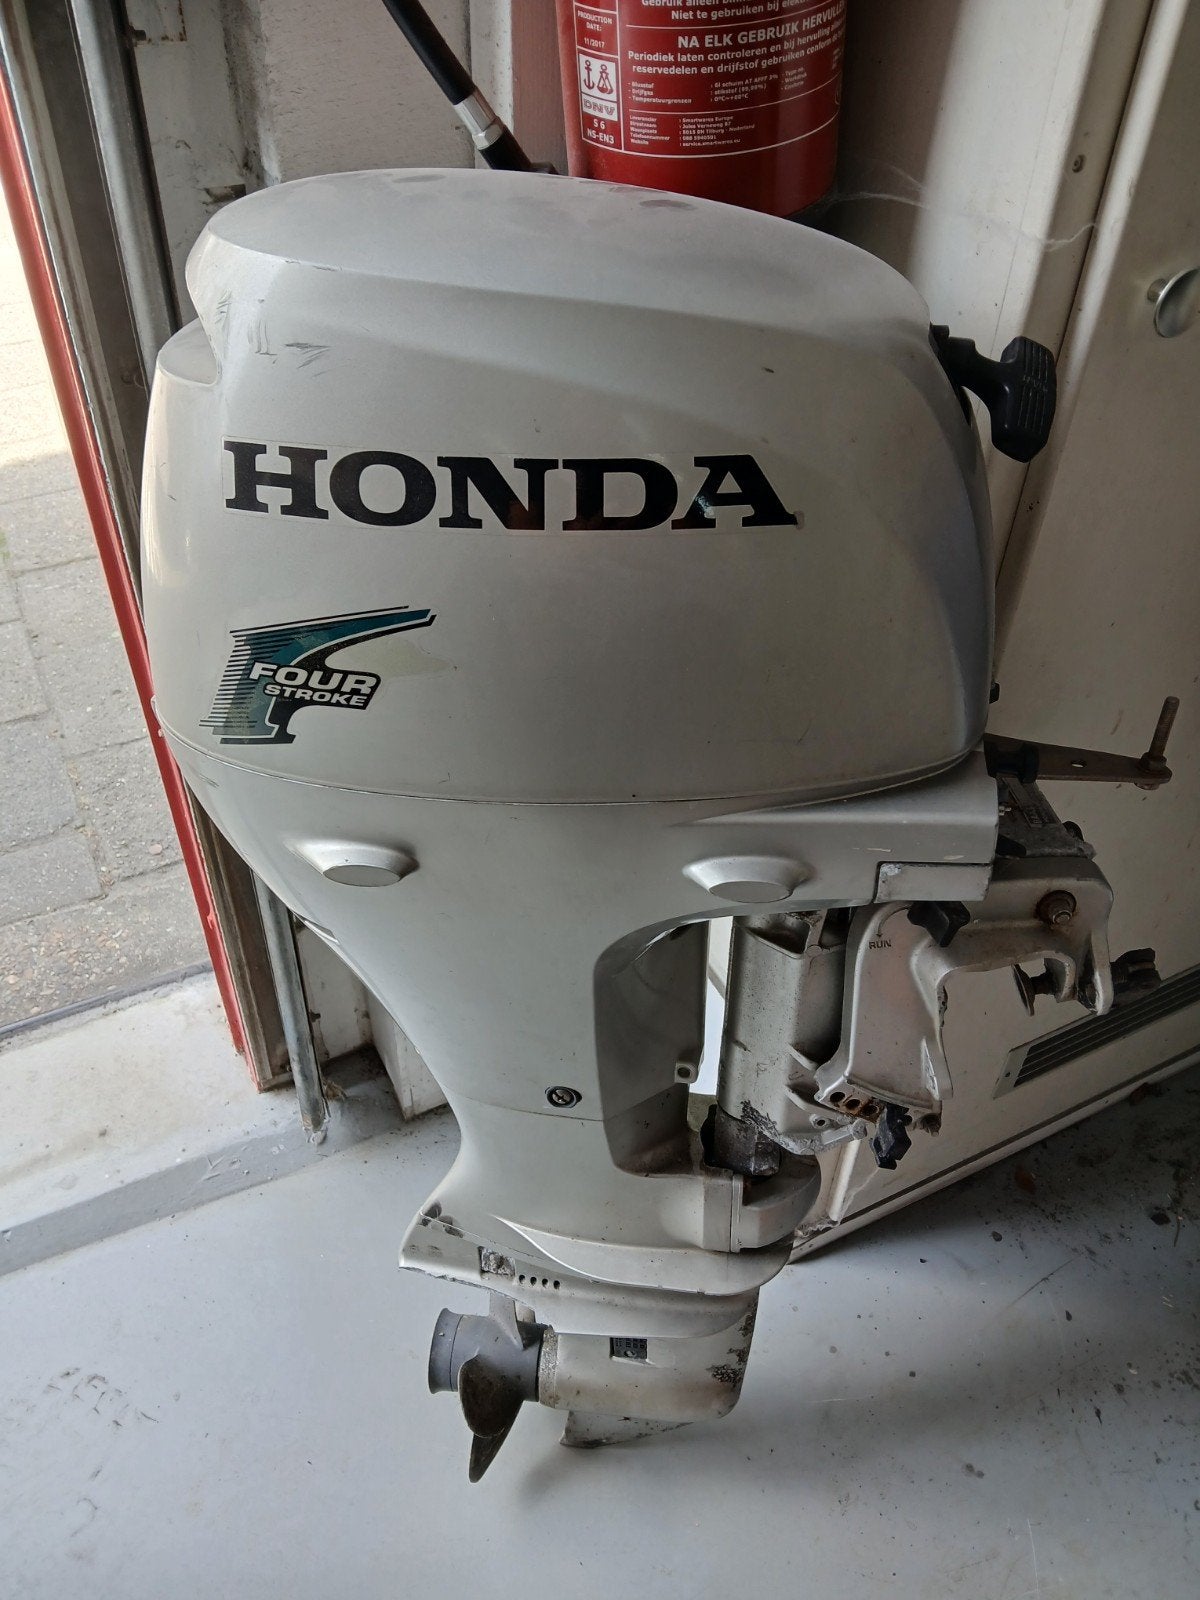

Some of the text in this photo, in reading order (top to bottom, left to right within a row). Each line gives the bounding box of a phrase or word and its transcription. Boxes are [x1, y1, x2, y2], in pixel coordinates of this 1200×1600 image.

[577, 10, 613, 24] PRODUCTION
[671, 10, 693, 19] Niet
[697, 10, 707, 18] te
[711, 5, 764, 20] gebruiken
[767, 1, 779, 11] bij
[677, 35, 700, 48] NA
[705, 34, 733, 47] ELK
[737, 21, 799, 44] GEBRUIK
[628, 50, 675, 61] Periodiek
[677, 53, 704, 61] laten
[707, 47, 767, 61] controleren
[770, 43, 781, 53] en
[783, 38, 796, 50] bij
[632, 65, 698, 74] reservedelen
[701, 66, 714, 74] en
[717, 61, 759, 73] drijfstof
[761, 50, 805, 69] gebruiken
[223, 439, 798, 532] HONDA
[249, 661, 378, 696] FOUR
[263, 684, 368, 707] STROKE
[868, 939, 892, 950] RUN
